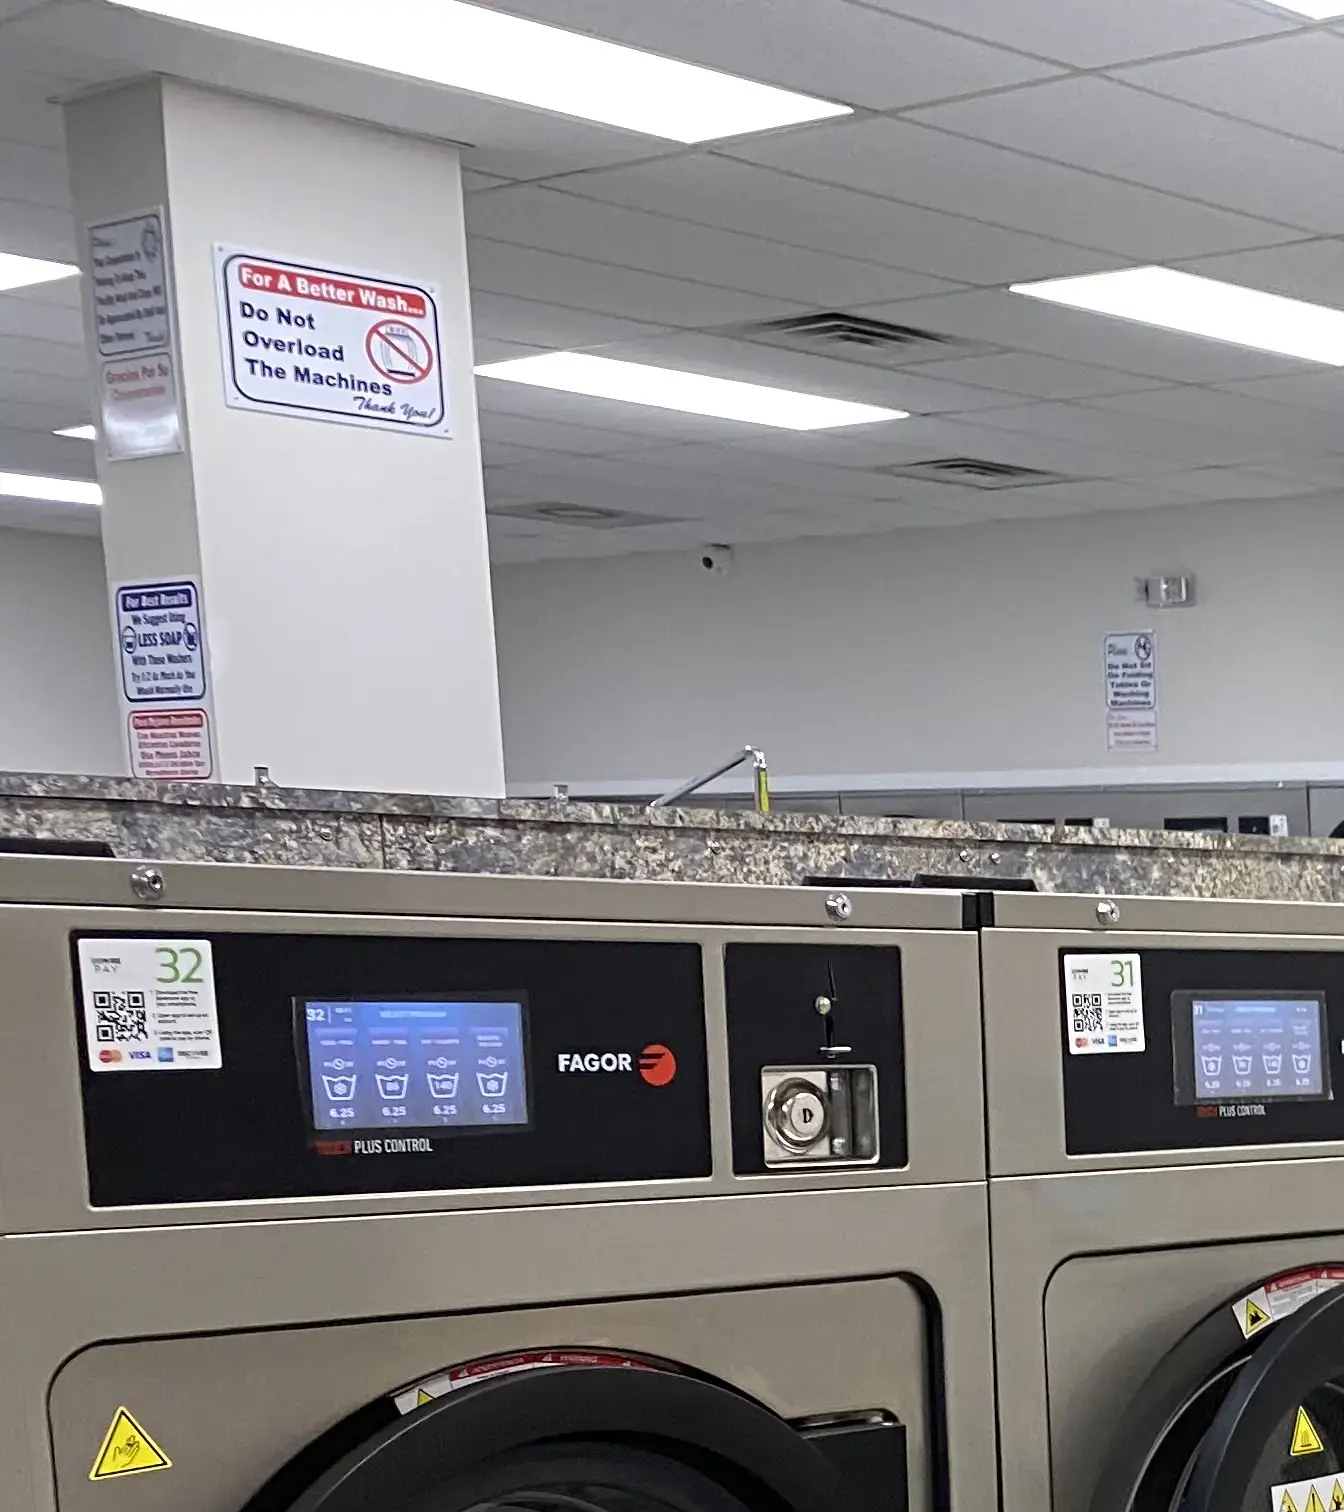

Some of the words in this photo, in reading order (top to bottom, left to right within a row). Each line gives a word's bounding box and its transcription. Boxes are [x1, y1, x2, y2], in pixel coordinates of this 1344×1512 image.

[241, 266, 272, 288] For
[278, 274, 291, 292] A
[296, 277, 355, 303] Better
[240, 301, 269, 321] Do
[276, 307, 317, 330] Not
[243, 331, 345, 361] Overload
[244, 357, 287, 380] The
[294, 365, 393, 396] Machines
[353, 396, 396, 415] Thank
[400, 403, 437, 420] You!
[138, 632, 158, 647] LESS
[159, 631, 182, 646] SOAP
[155, 947, 204, 983] 32
[1111, 960, 1134, 987] 31
[306, 1008, 326, 1021] 32
[128, 1051, 152, 1060] VISA
[558, 1053, 632, 1072] FAGOR
[1219, 1105, 1236, 1117] PLUS
[1237, 1104, 1266, 1116] CONTROL
[354, 1139, 382, 1154] PLUS
[384, 1138, 434, 1153] CONTROL
